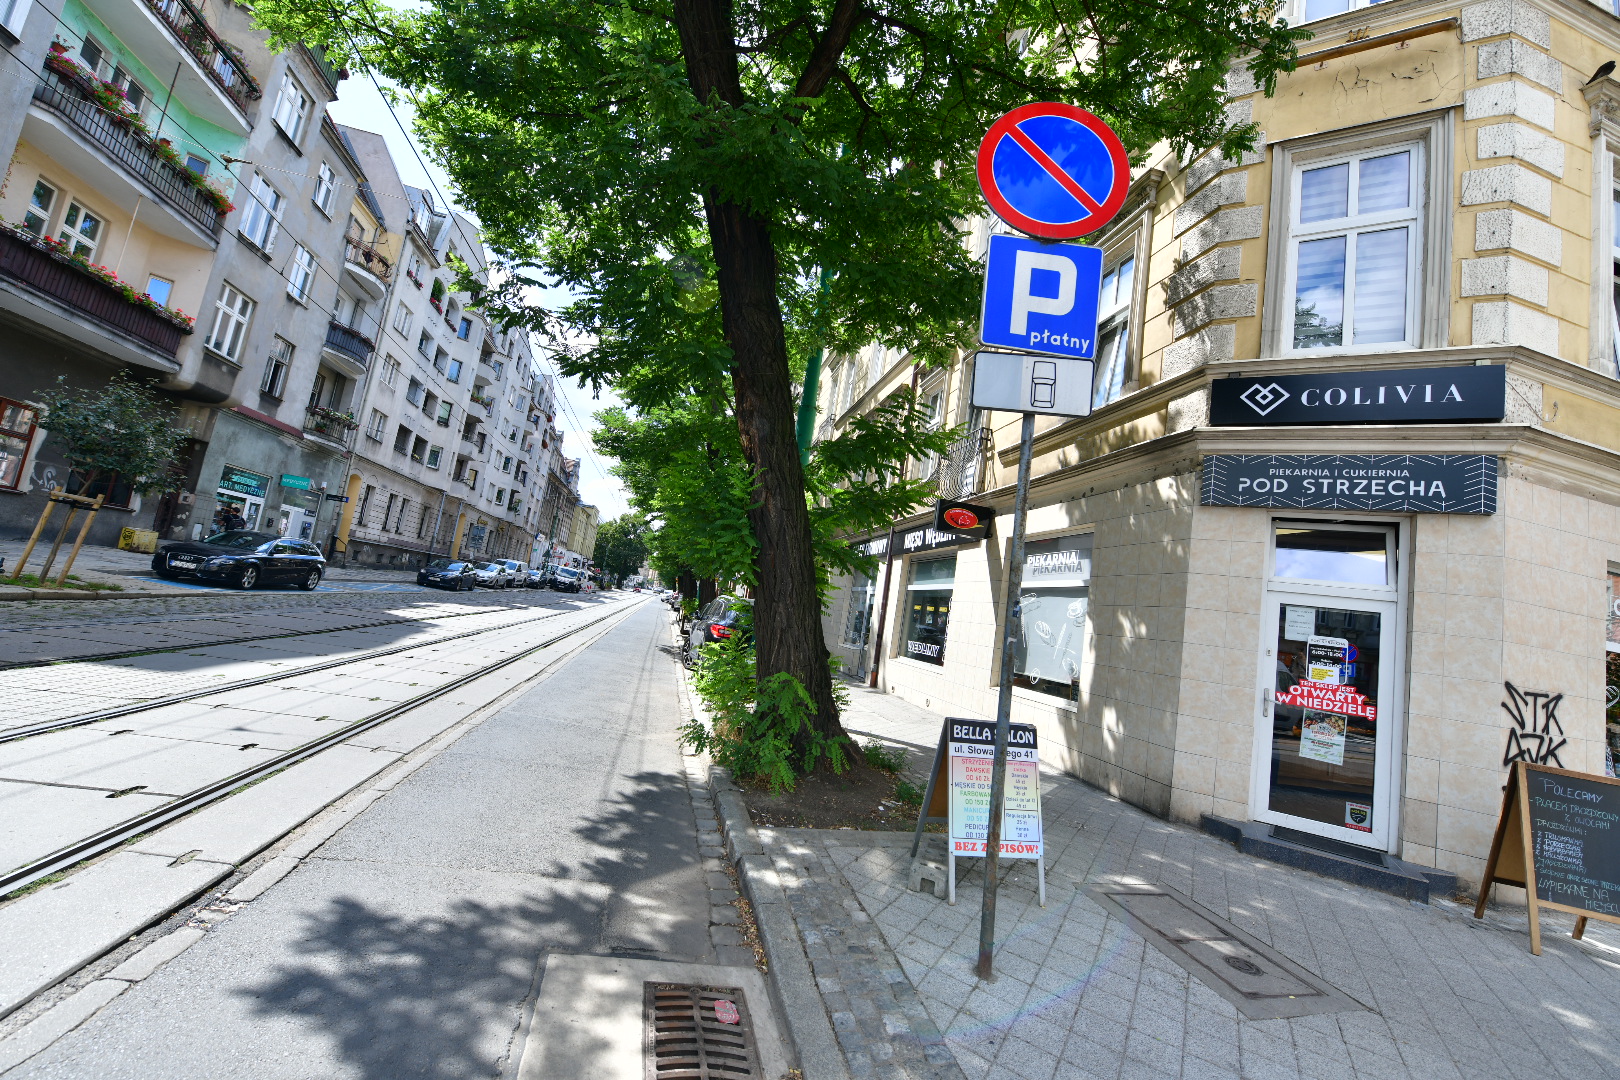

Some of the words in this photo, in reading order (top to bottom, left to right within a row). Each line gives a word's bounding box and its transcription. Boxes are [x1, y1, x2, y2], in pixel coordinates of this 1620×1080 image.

[1009, 249, 1078, 336] P
[1029, 329, 1090, 354] płatny
[1300, 383, 1465, 407] COLIVIA
[1269, 468, 1330, 477] PIEKARNIA
[1334, 468, 1338, 477] I
[1342, 468, 1410, 477] CUKIERNIA
[219, 480, 233, 490] ART.
[234, 483, 266, 498] MEDYCZNE
[1238, 478, 1289, 493] POD
[903, 530, 924, 552] MIĘSO
[1027, 551, 1077, 568] PIEKARNIA
[1289, 685, 1366, 705] OTWARTY
[1315, 682, 1338, 690] SKLEP
[1338, 685, 1355, 693] JEST
[1276, 692, 1293, 704] W
[1296, 696, 1375, 720] NIEDZIELĘ
[953, 724, 992, 741] BELLA
[954, 745, 965, 754] ul.
[1024, 750, 1033, 759] 41
[965, 766, 991, 775] DAMSKIE
[954, 781, 976, 790] MĘSKIE
[1539, 777, 1604, 803] POLECAMY
[1534, 796, 1568, 813] PLACEK
[954, 841, 978, 852] BEZ
[981, 841, 1039, 855] ZPISÓW!
[1537, 877, 1590, 899] WYPIEKANE
[1592, 888, 1610, 902] NA
